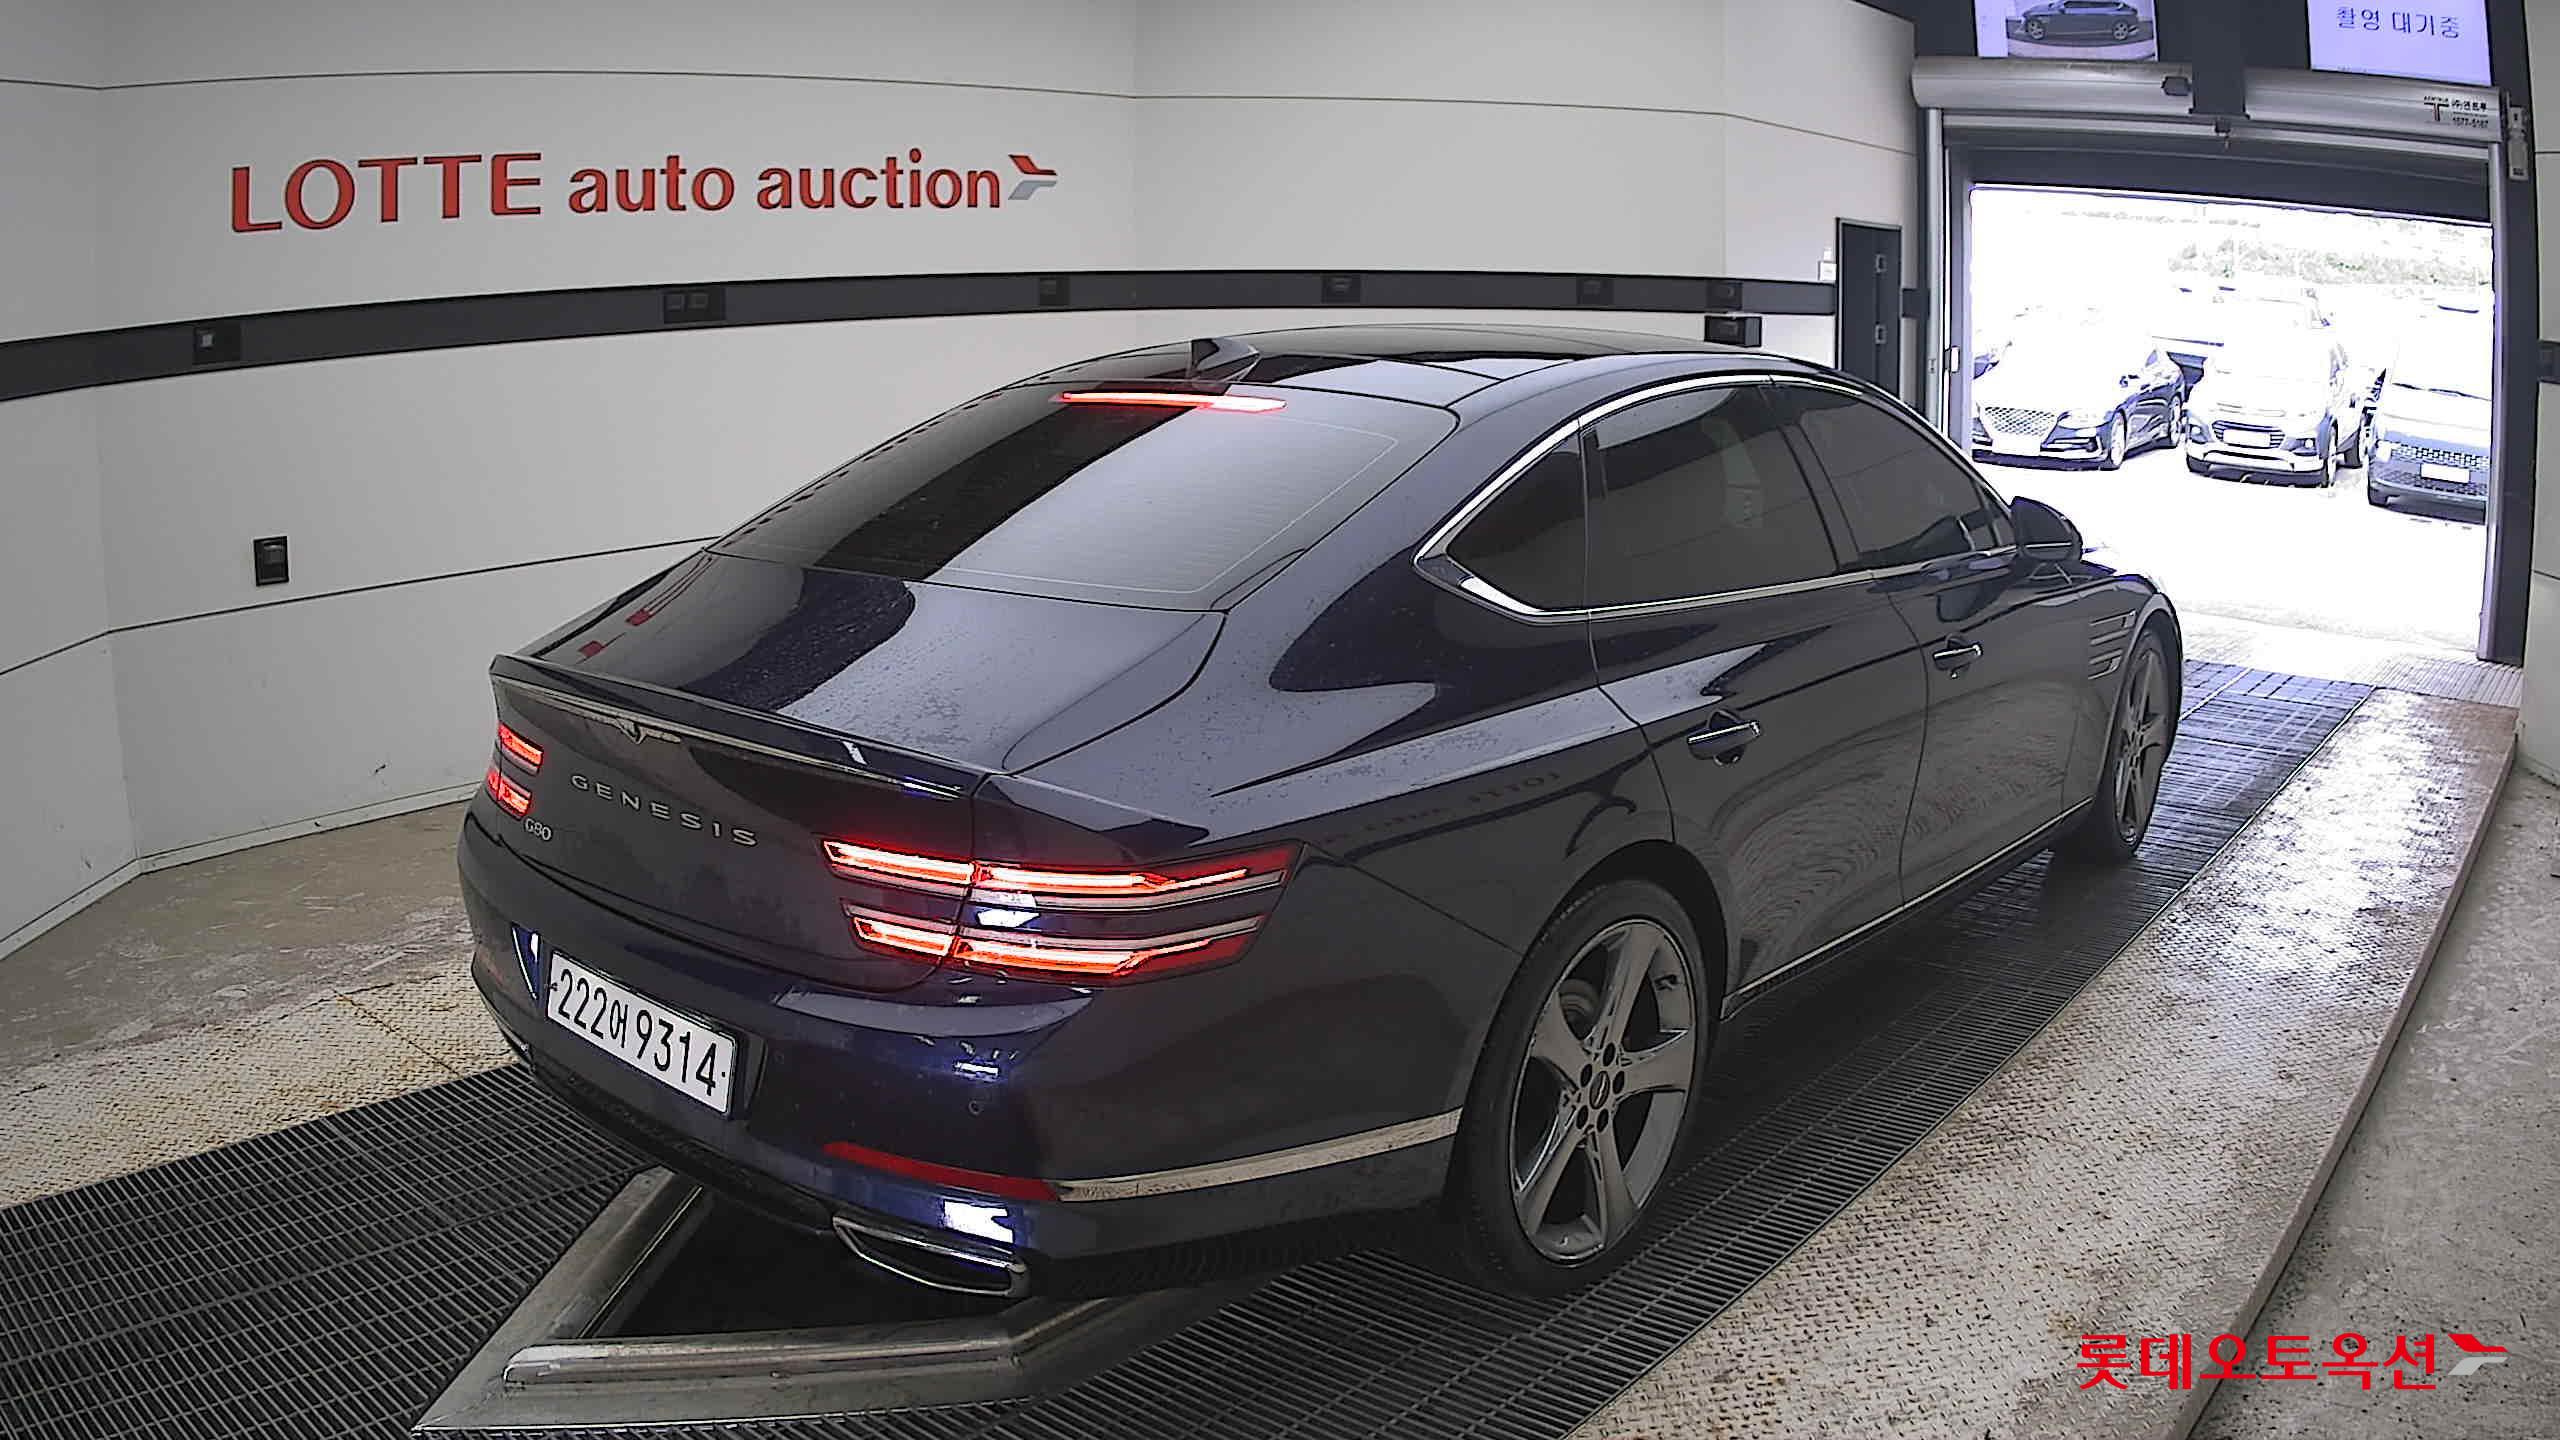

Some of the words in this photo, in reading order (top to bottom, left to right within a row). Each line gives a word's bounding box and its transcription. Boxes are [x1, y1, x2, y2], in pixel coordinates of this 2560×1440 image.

[2337, 6, 2380, 31] 촬영
[2391, 11, 2460, 39] 대기중
[231, 152, 542, 233] LOTTE
[568, 154, 735, 213] auto
[757, 148, 1001, 209] auction
[523, 818, 552, 841] G80
[570, 774, 758, 847] GENESIS
